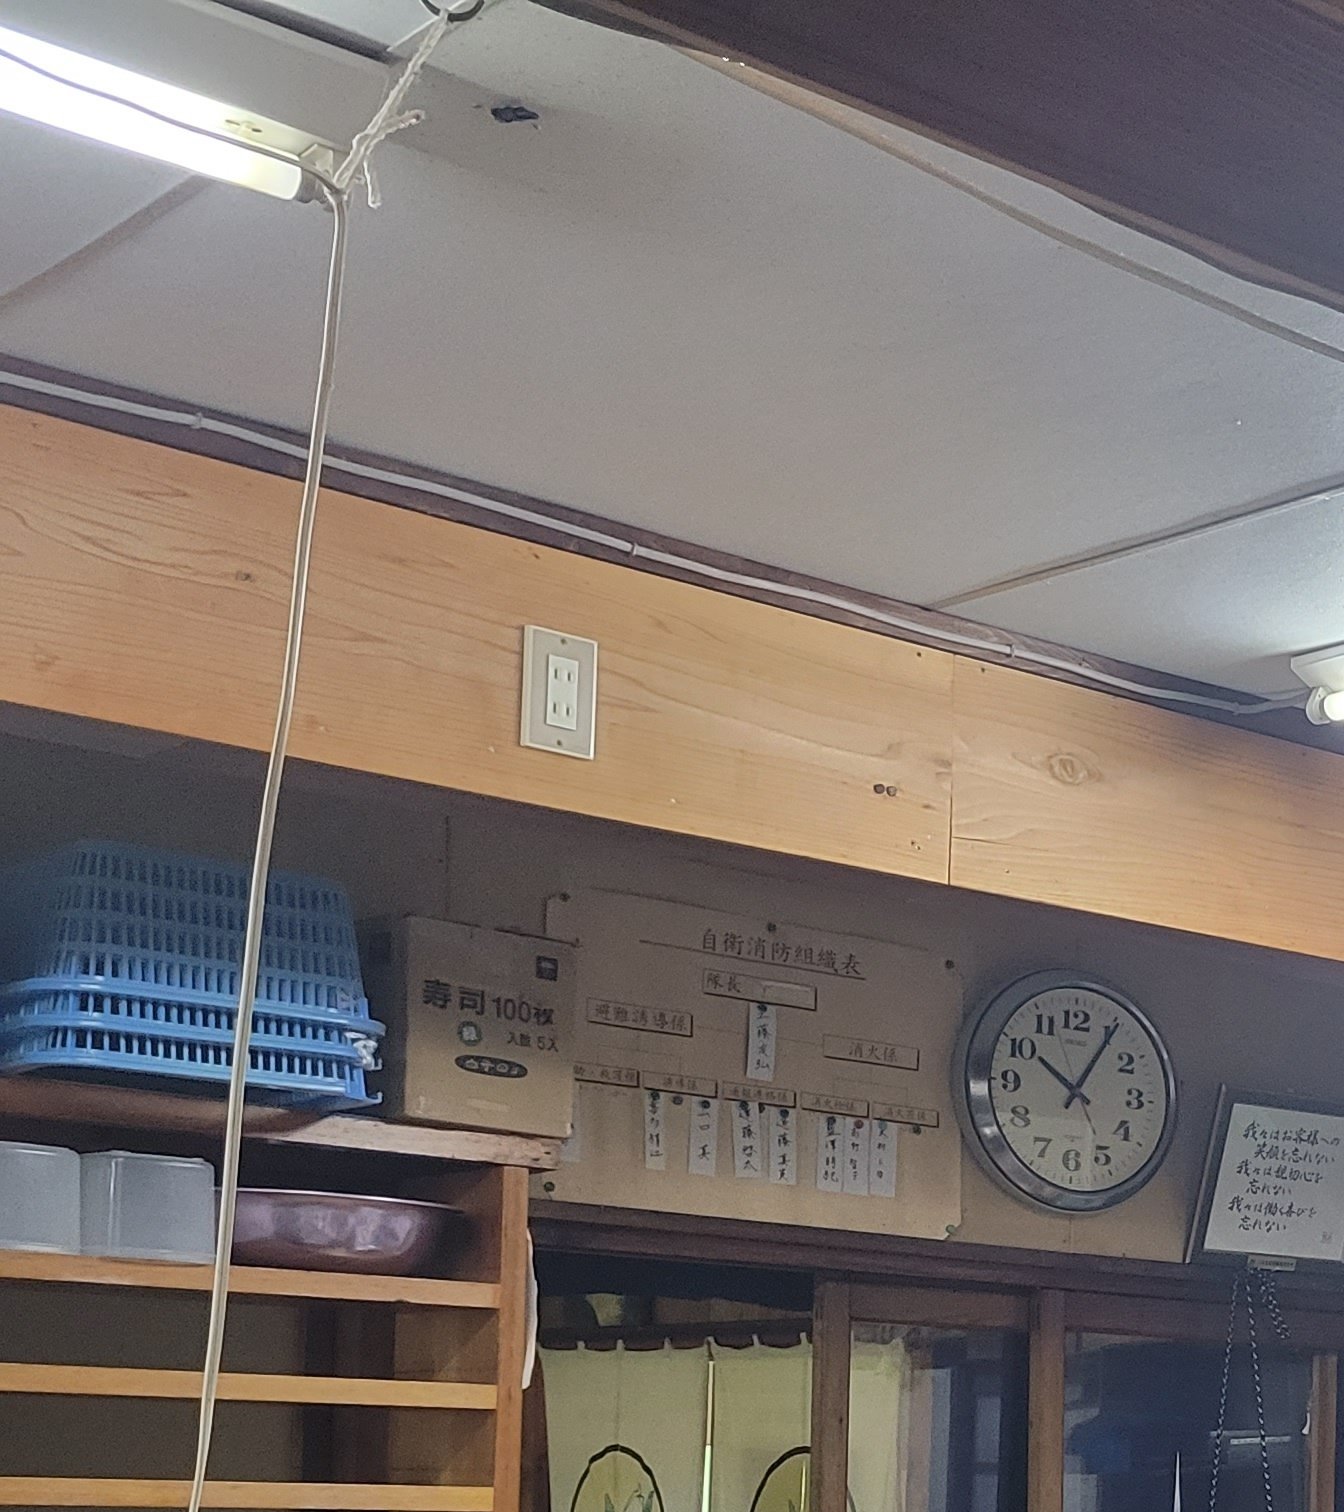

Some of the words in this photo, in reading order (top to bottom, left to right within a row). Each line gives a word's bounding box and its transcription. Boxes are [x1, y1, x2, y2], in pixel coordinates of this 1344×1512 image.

[1035, 1013, 1055, 1036] 11
[1062, 1009, 1090, 1032] 12
[1008, 1037, 1037, 1060] 10
[1117, 1052, 1135, 1075] 2
[1001, 1069, 1021, 1092] 9
[1126, 1087, 1144, 1110] 3
[1010, 1105, 1031, 1128] 8
[1113, 1120, 1131, 1142] 4
[1033, 1136, 1053, 1158] 7
[1094, 1145, 1111, 1166] 5
[1062, 1149, 1081, 1172] 6
